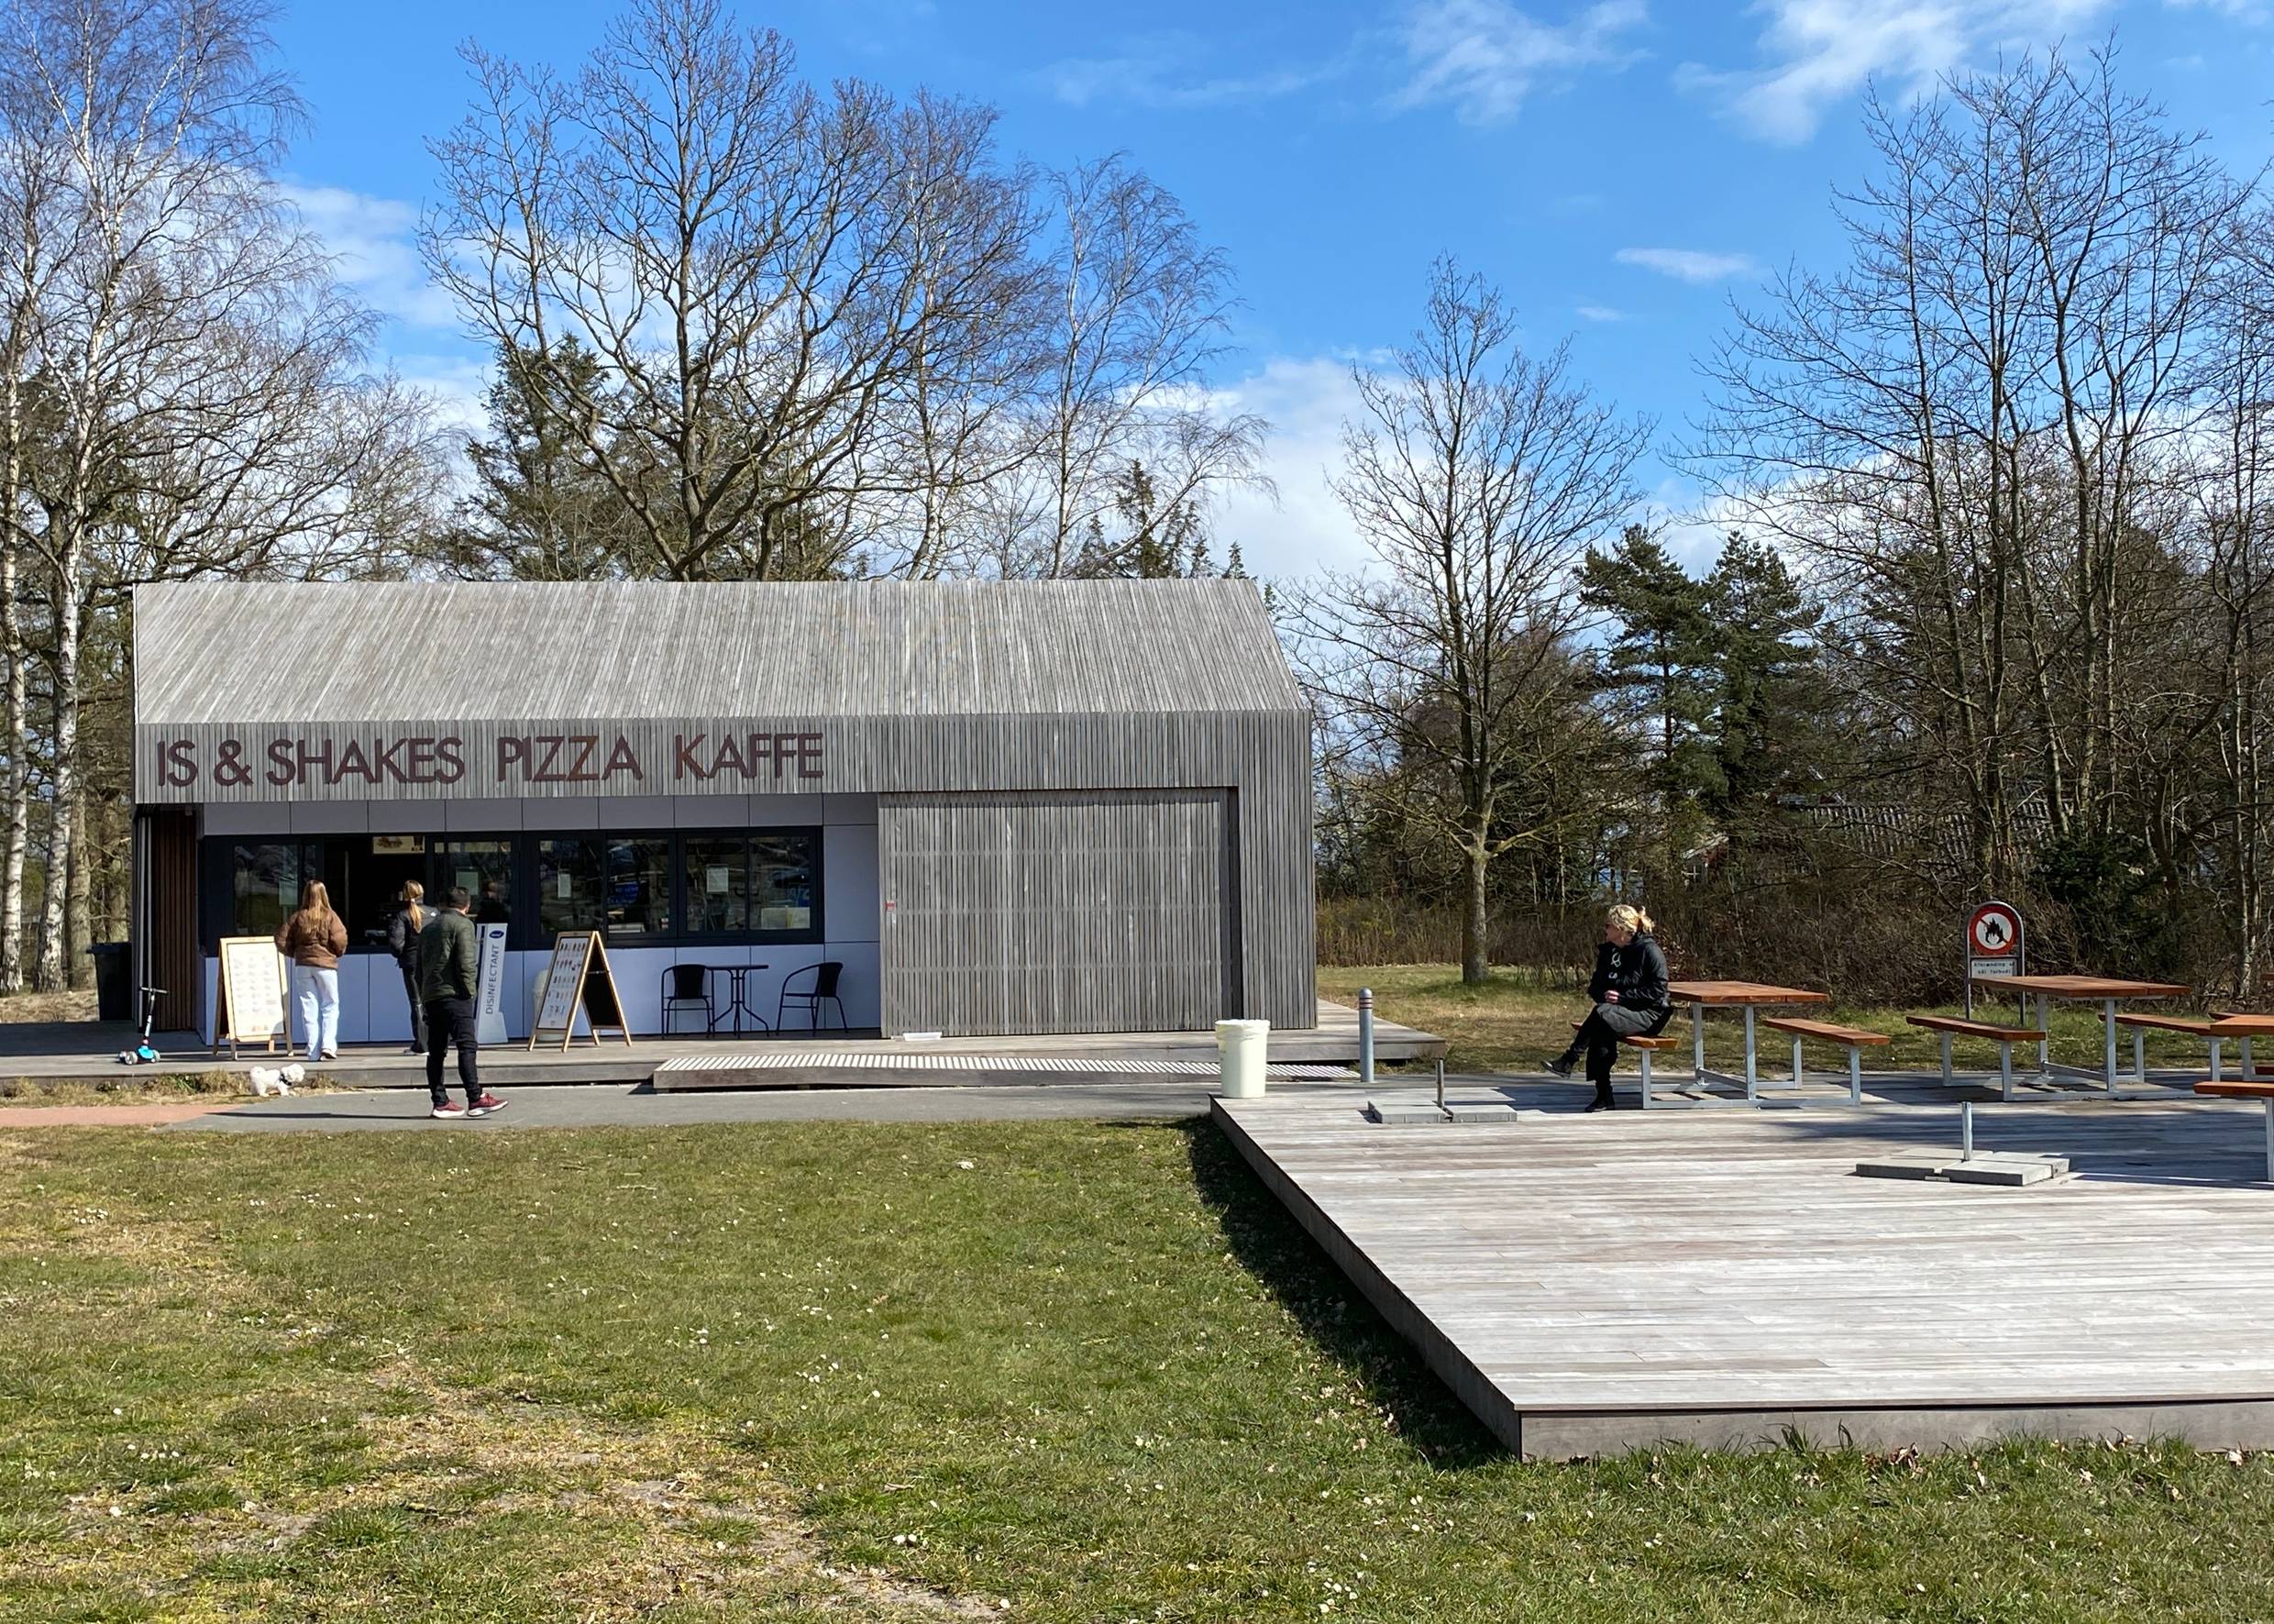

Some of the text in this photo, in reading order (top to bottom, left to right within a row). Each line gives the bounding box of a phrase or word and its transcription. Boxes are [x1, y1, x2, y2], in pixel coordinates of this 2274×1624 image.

[157, 733, 824, 787] IS & SHAKES PIZZA KAFFE
[486, 945, 499, 1014] DISINFECTANT
